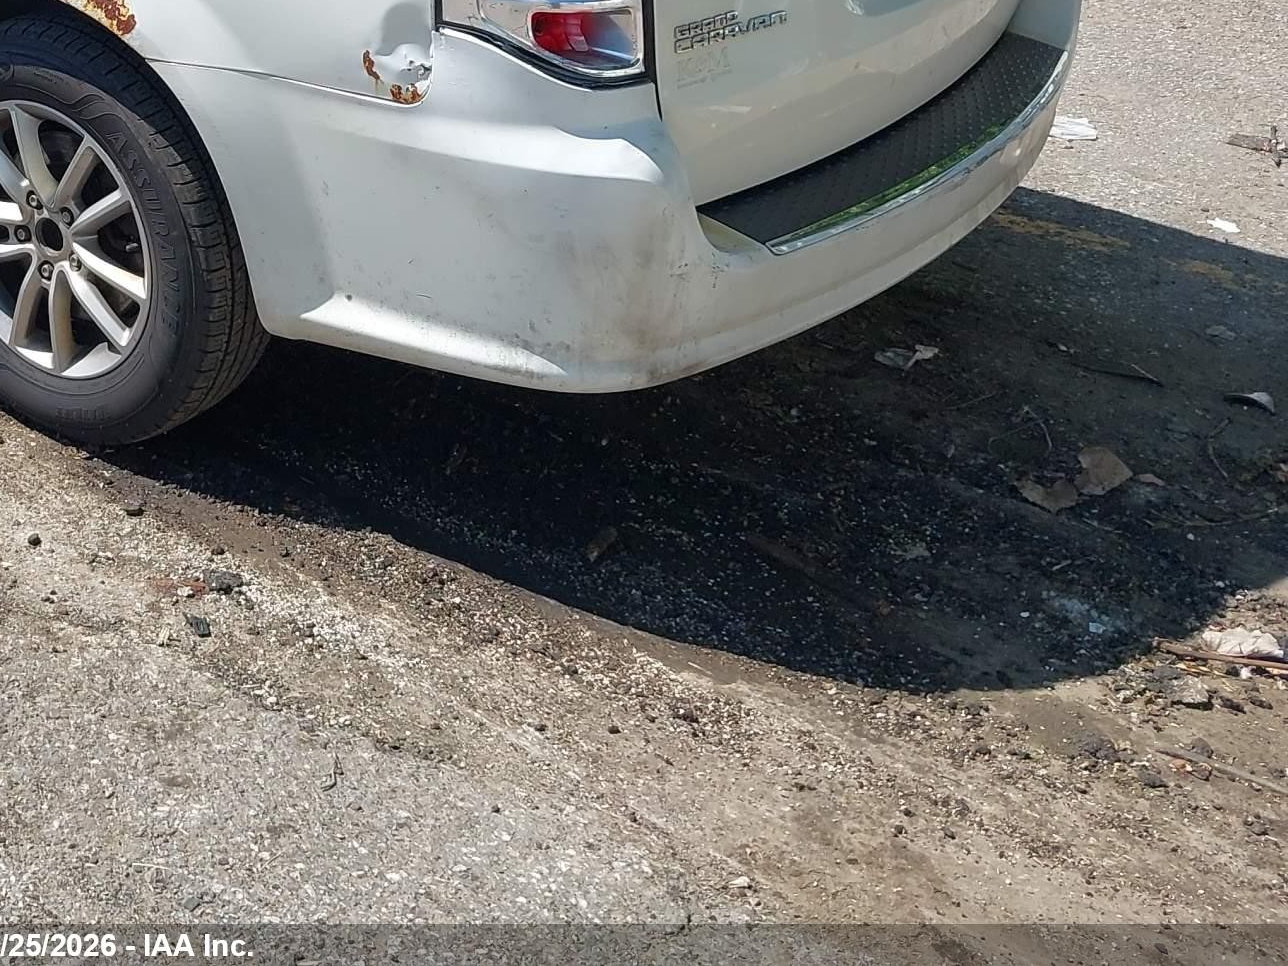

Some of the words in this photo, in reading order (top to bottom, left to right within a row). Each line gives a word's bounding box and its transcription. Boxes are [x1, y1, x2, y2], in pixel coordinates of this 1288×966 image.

[673, 9, 739, 39] GRAND
[673, 10, 788, 54] CARAVAN
[104, 128, 185, 336] ASSURANCE
